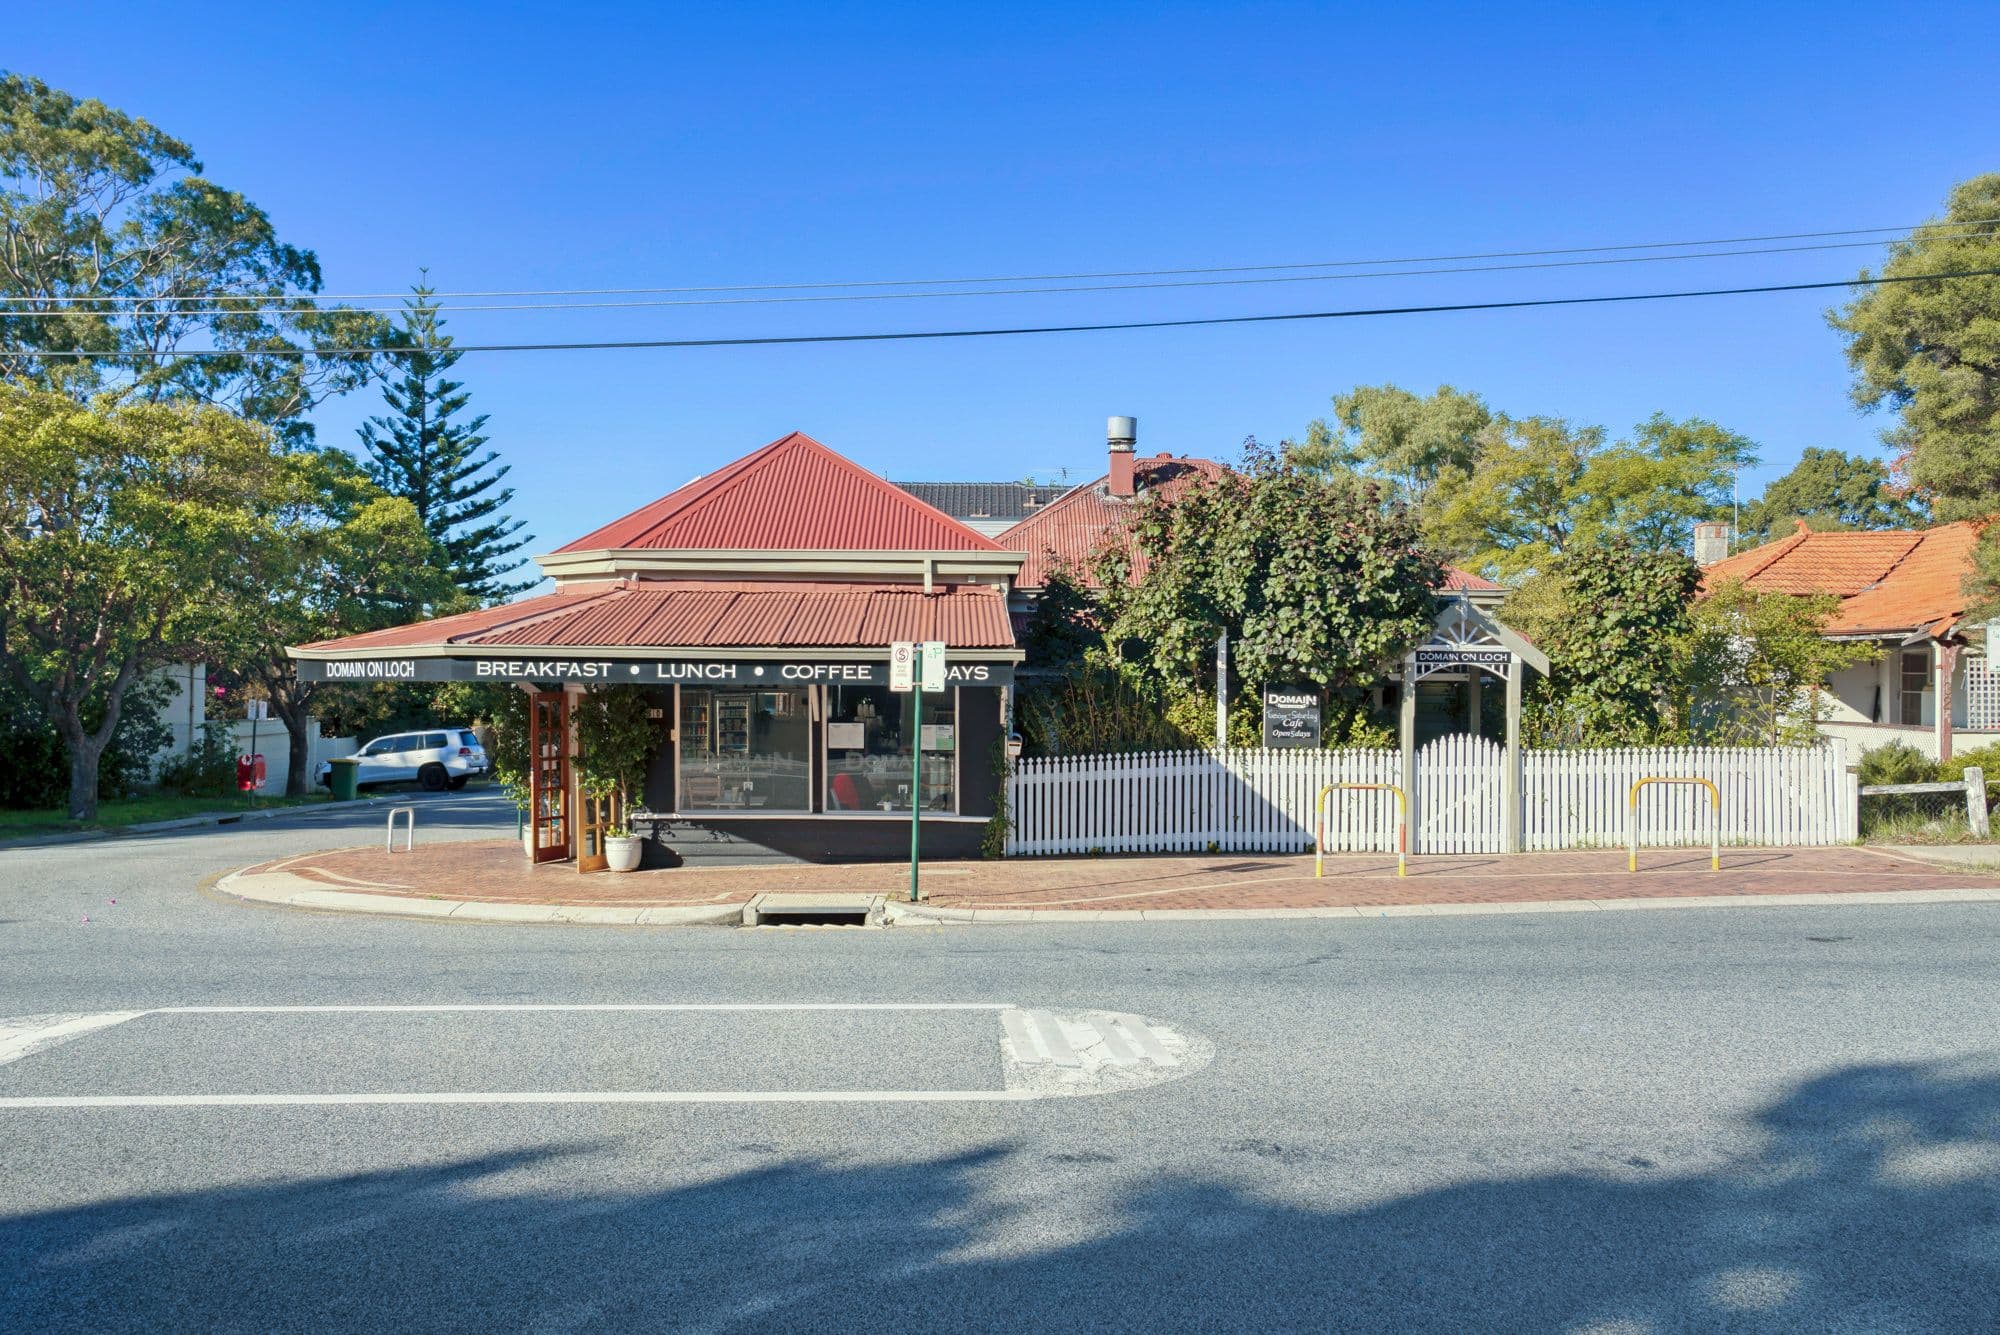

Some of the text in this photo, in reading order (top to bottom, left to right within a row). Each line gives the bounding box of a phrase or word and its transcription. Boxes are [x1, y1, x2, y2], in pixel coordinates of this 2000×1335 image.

[1419, 652, 1508, 662] DOMAIN ON LOCH
[326, 661, 415, 677] DOMAIN ON LOCH
[476, 661, 989, 680] BREAKFAST LUNCH COFFEE AYS
[1268, 694, 1317, 706] DOMAIN
[1282, 718, 1304, 729] Cafe
